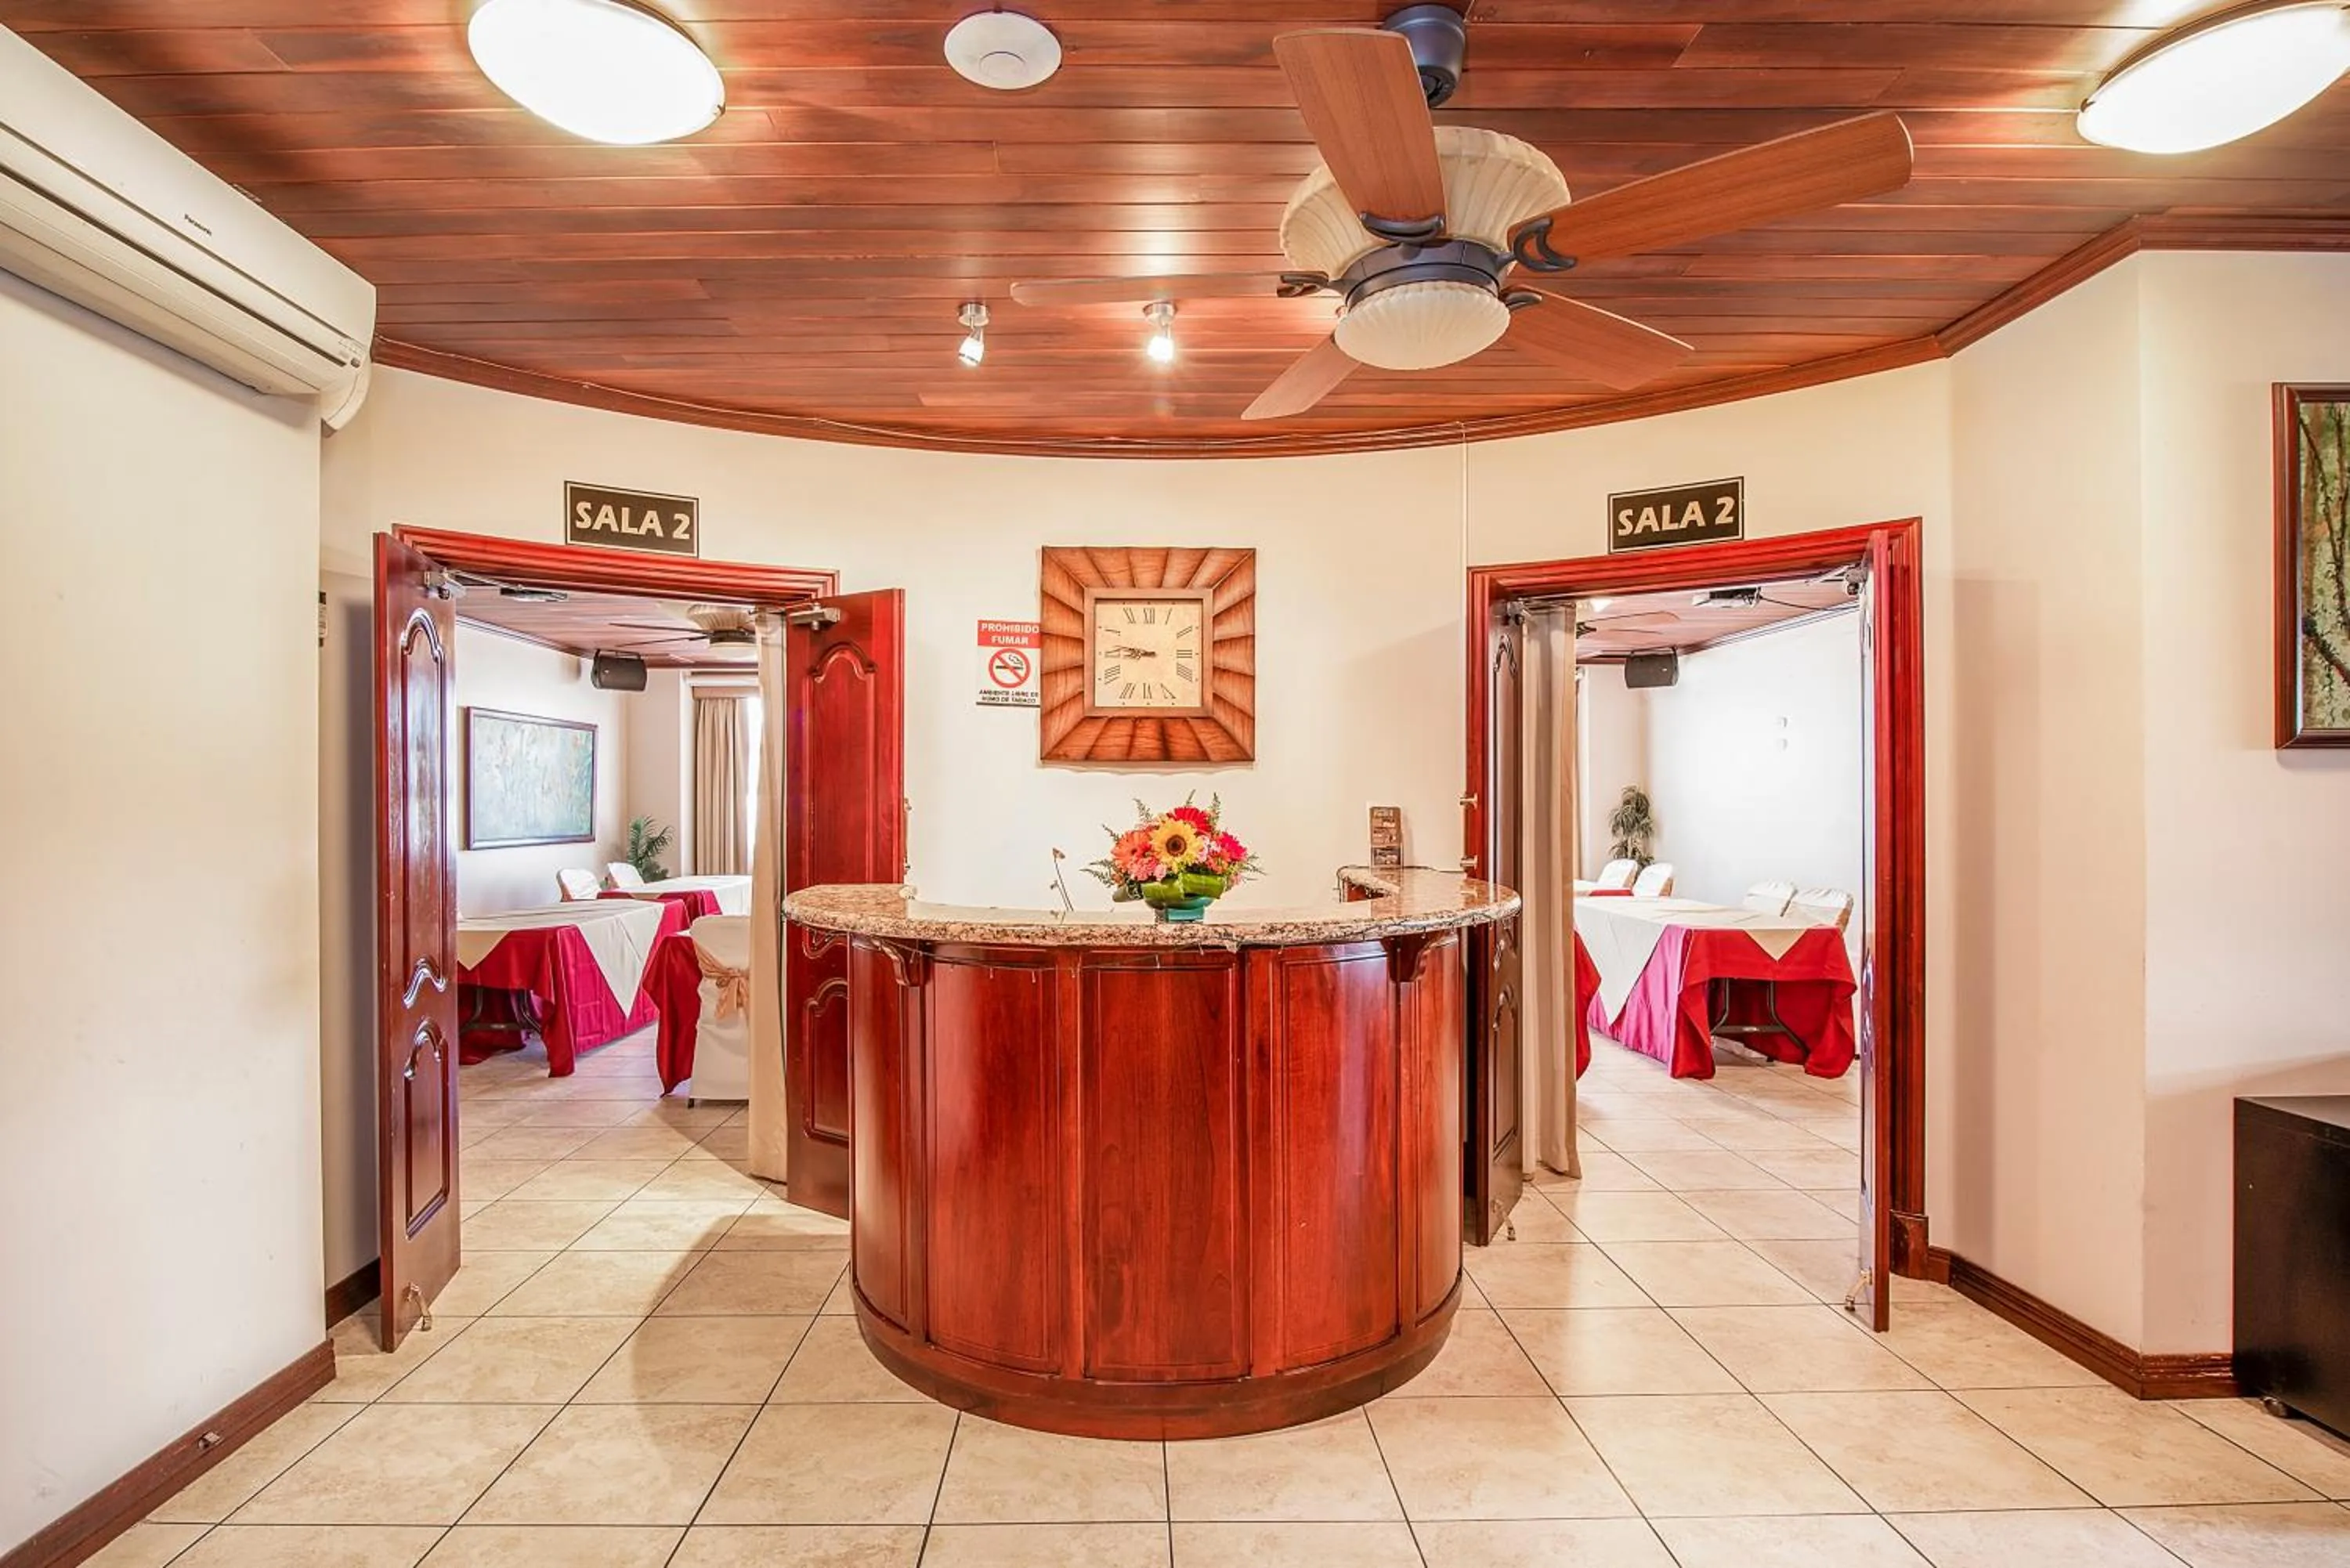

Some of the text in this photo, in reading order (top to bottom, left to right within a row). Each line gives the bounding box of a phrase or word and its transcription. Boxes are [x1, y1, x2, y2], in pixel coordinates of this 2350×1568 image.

[576, 500, 691, 540] SALA 2
[1618, 496, 1735, 537] SALA 2
[981, 623, 1039, 634] PROHIBIDO
[991, 635, 1029, 645] FUMAR
